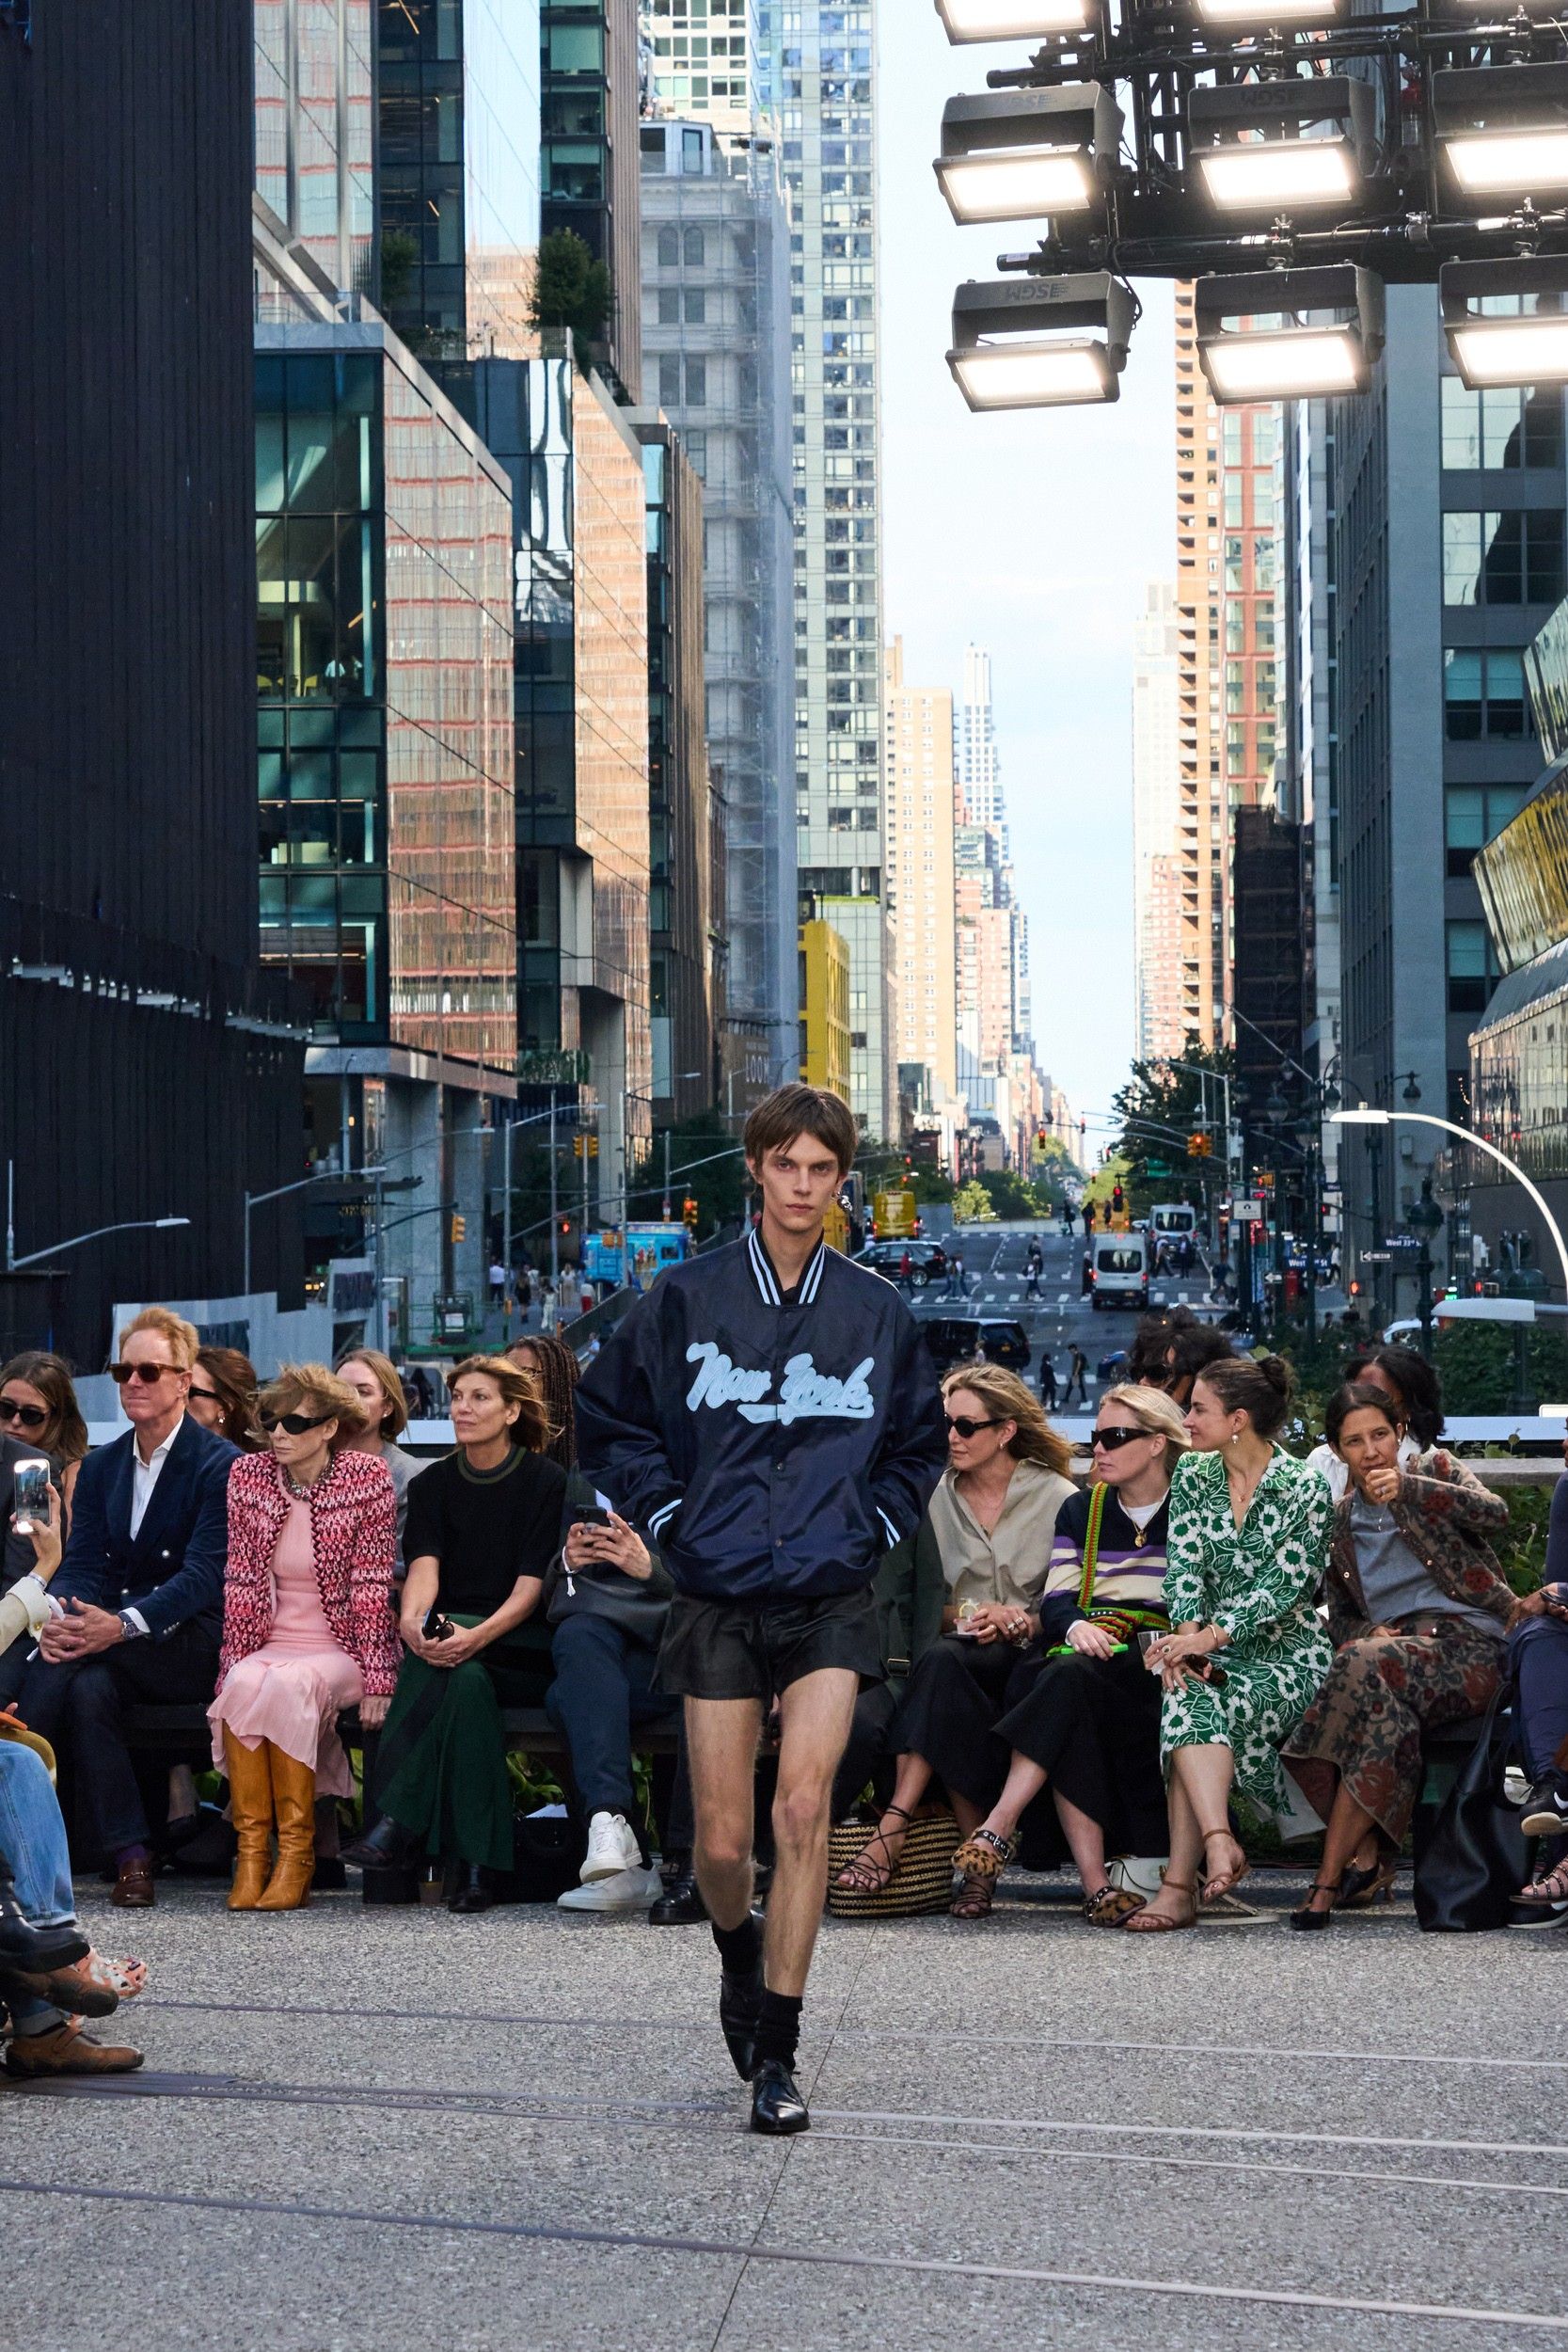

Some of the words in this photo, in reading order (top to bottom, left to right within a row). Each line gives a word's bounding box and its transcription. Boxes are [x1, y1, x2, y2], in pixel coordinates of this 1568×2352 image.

[1289, 1259, 1306, 1267] West
[686, 1342, 772, 1412] New
[780, 1352, 875, 1426] York
